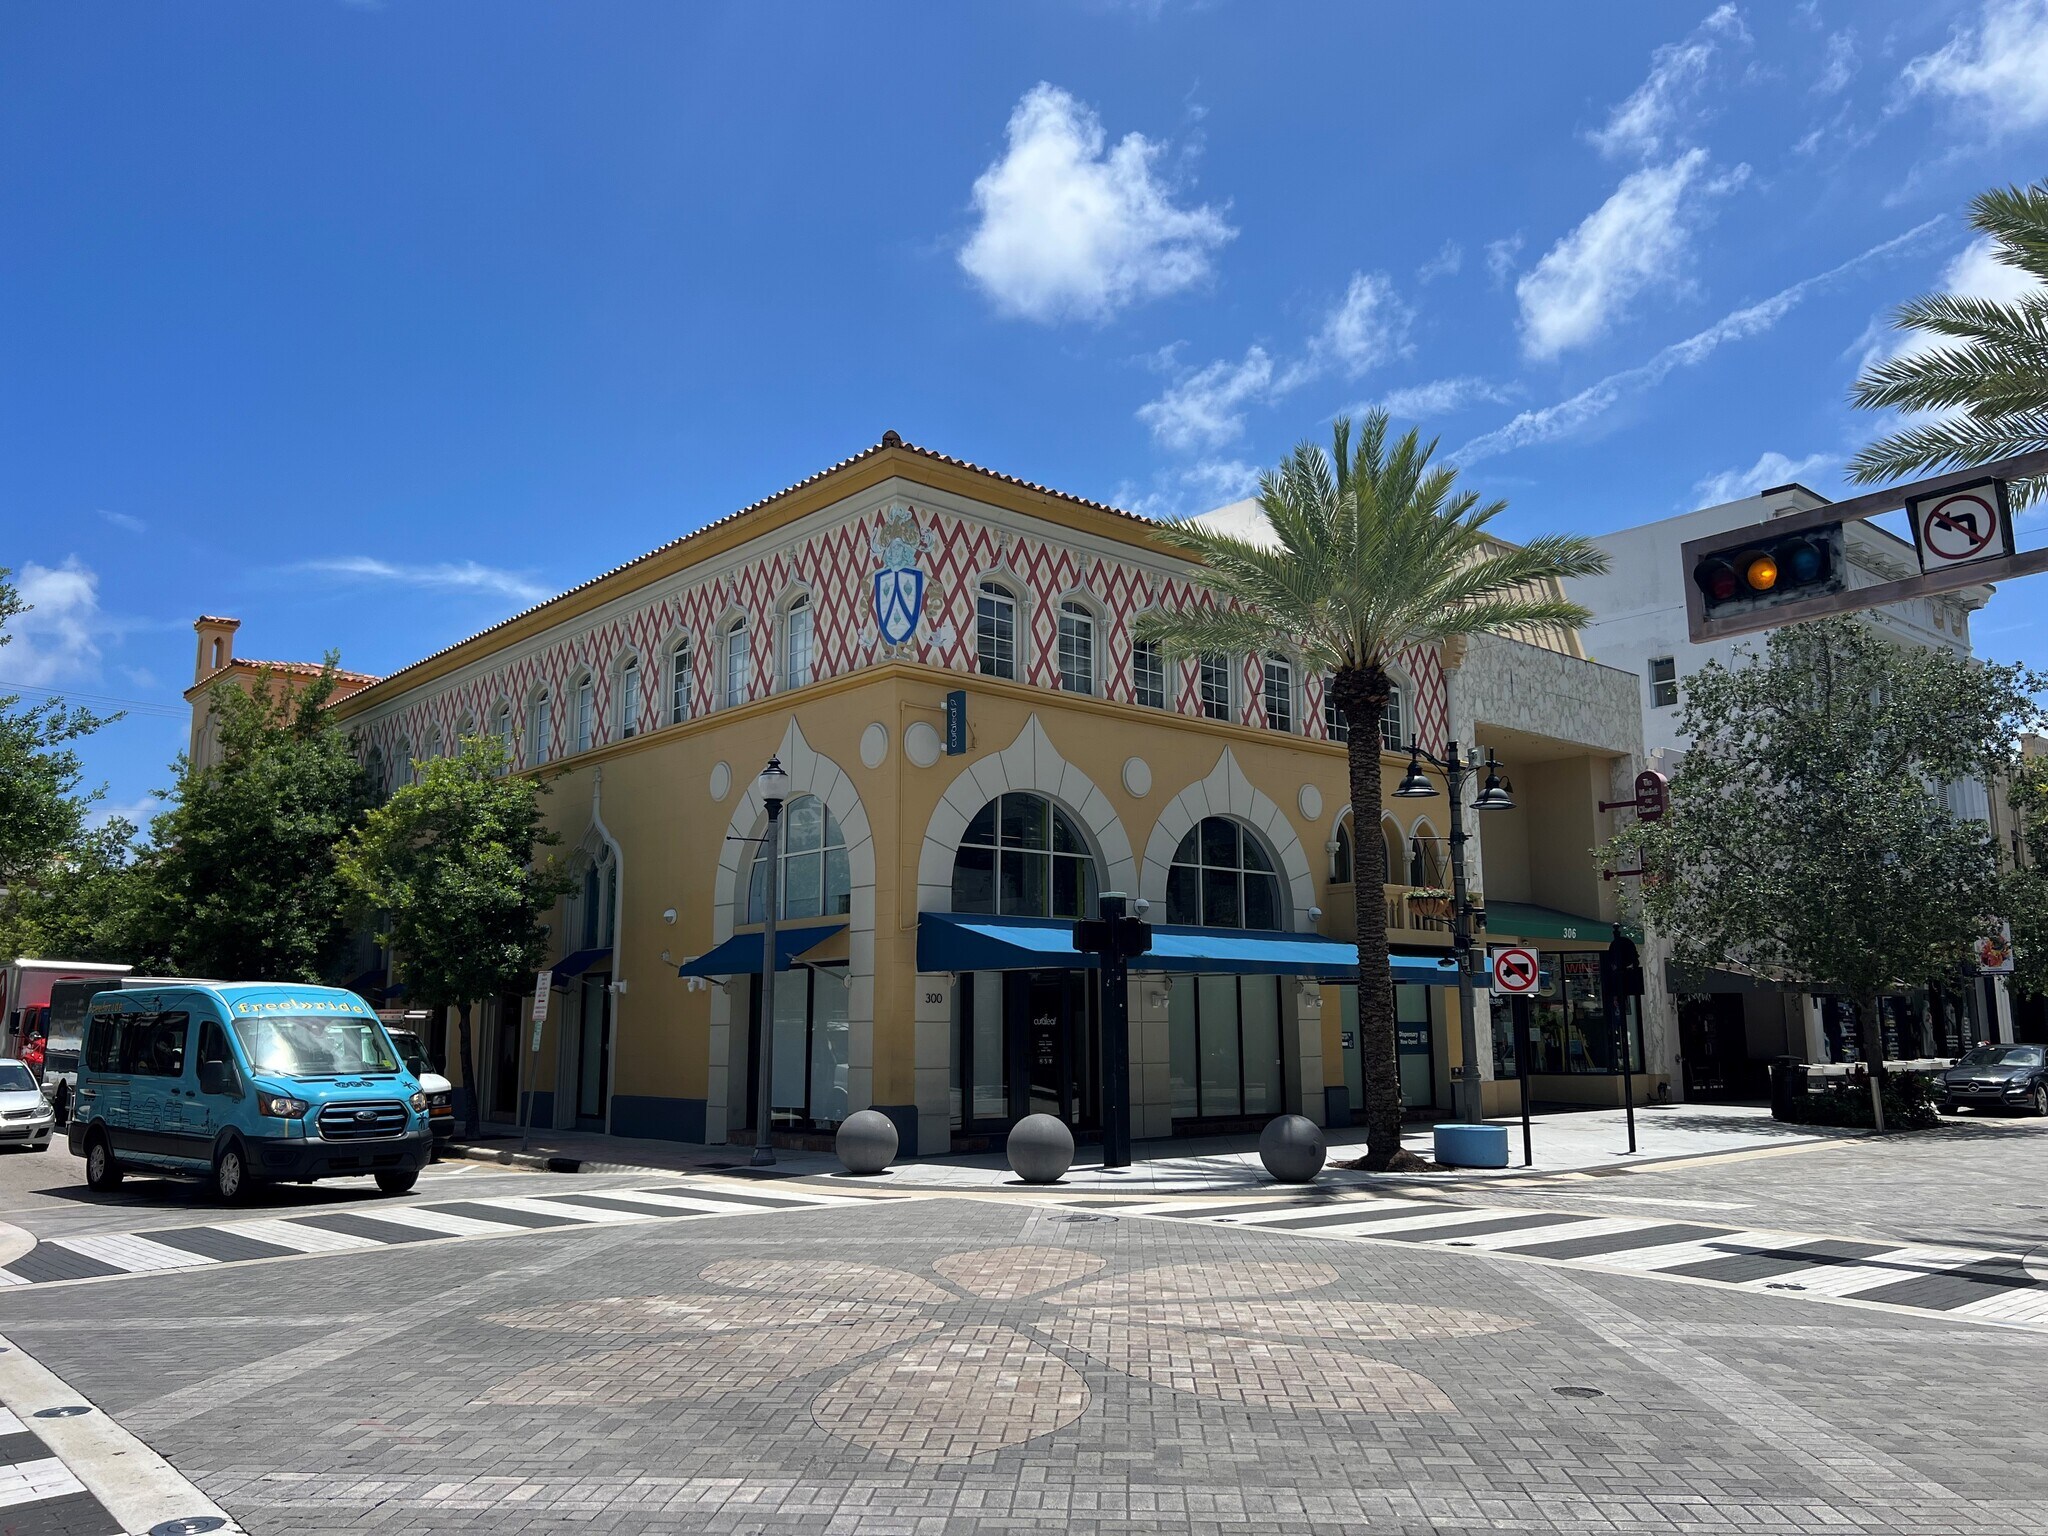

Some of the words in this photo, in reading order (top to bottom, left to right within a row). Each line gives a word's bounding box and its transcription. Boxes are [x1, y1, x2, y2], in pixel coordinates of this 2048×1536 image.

[1563, 927, 1577, 939] 306
[1566, 962, 1600, 973] WINE
[925, 993, 943, 1003] 300
